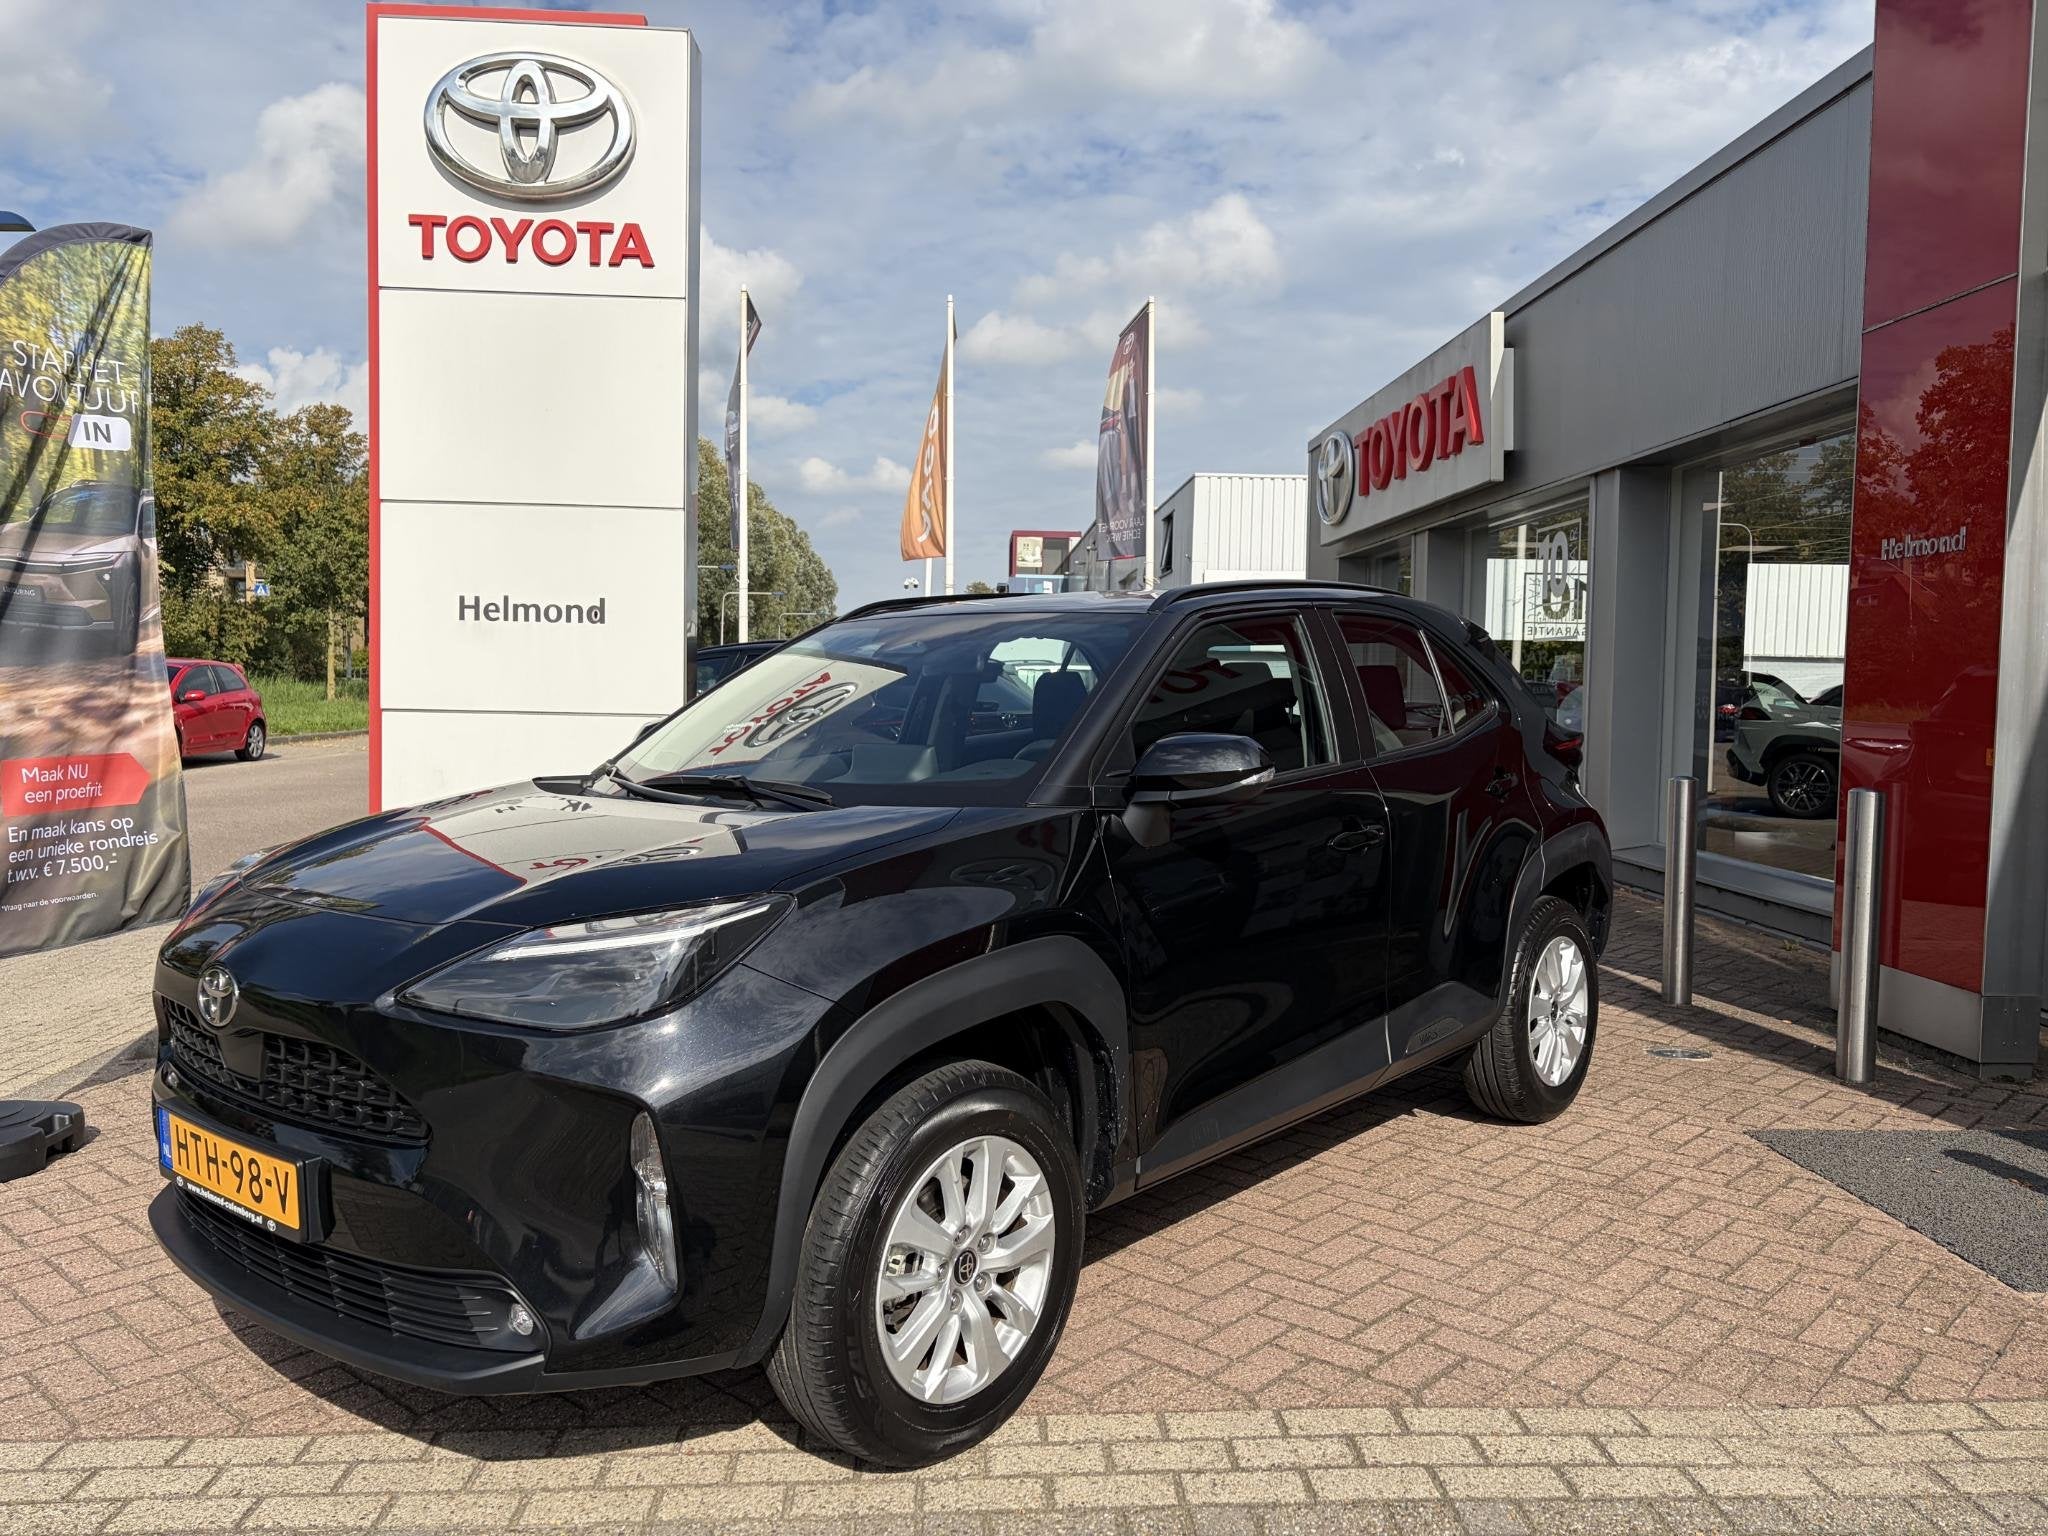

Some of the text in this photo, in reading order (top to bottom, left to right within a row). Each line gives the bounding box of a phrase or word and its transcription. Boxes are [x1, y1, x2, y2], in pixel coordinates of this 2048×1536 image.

[408, 213, 655, 269] TOYOTA
[13, 340, 75, 376] STAP
[83, 421, 112, 443] IN
[1354, 365, 1485, 497] TOYOTA
[1880, 526, 1967, 561] Helmond
[458, 594, 606, 625] Helmond
[21, 763, 89, 784] Maak NU
[24, 782, 103, 804] een proefrit
[8, 816, 134, 843] En maak kans op
[8, 830, 159, 863] een unieke rondreis
[7, 866, 39, 884] t.w.v.
[43, 861, 53, 877] €
[23, 900, 38, 909] naar
[39, 898, 50, 906] de
[175, 1123, 290, 1215] HTH-98-V
